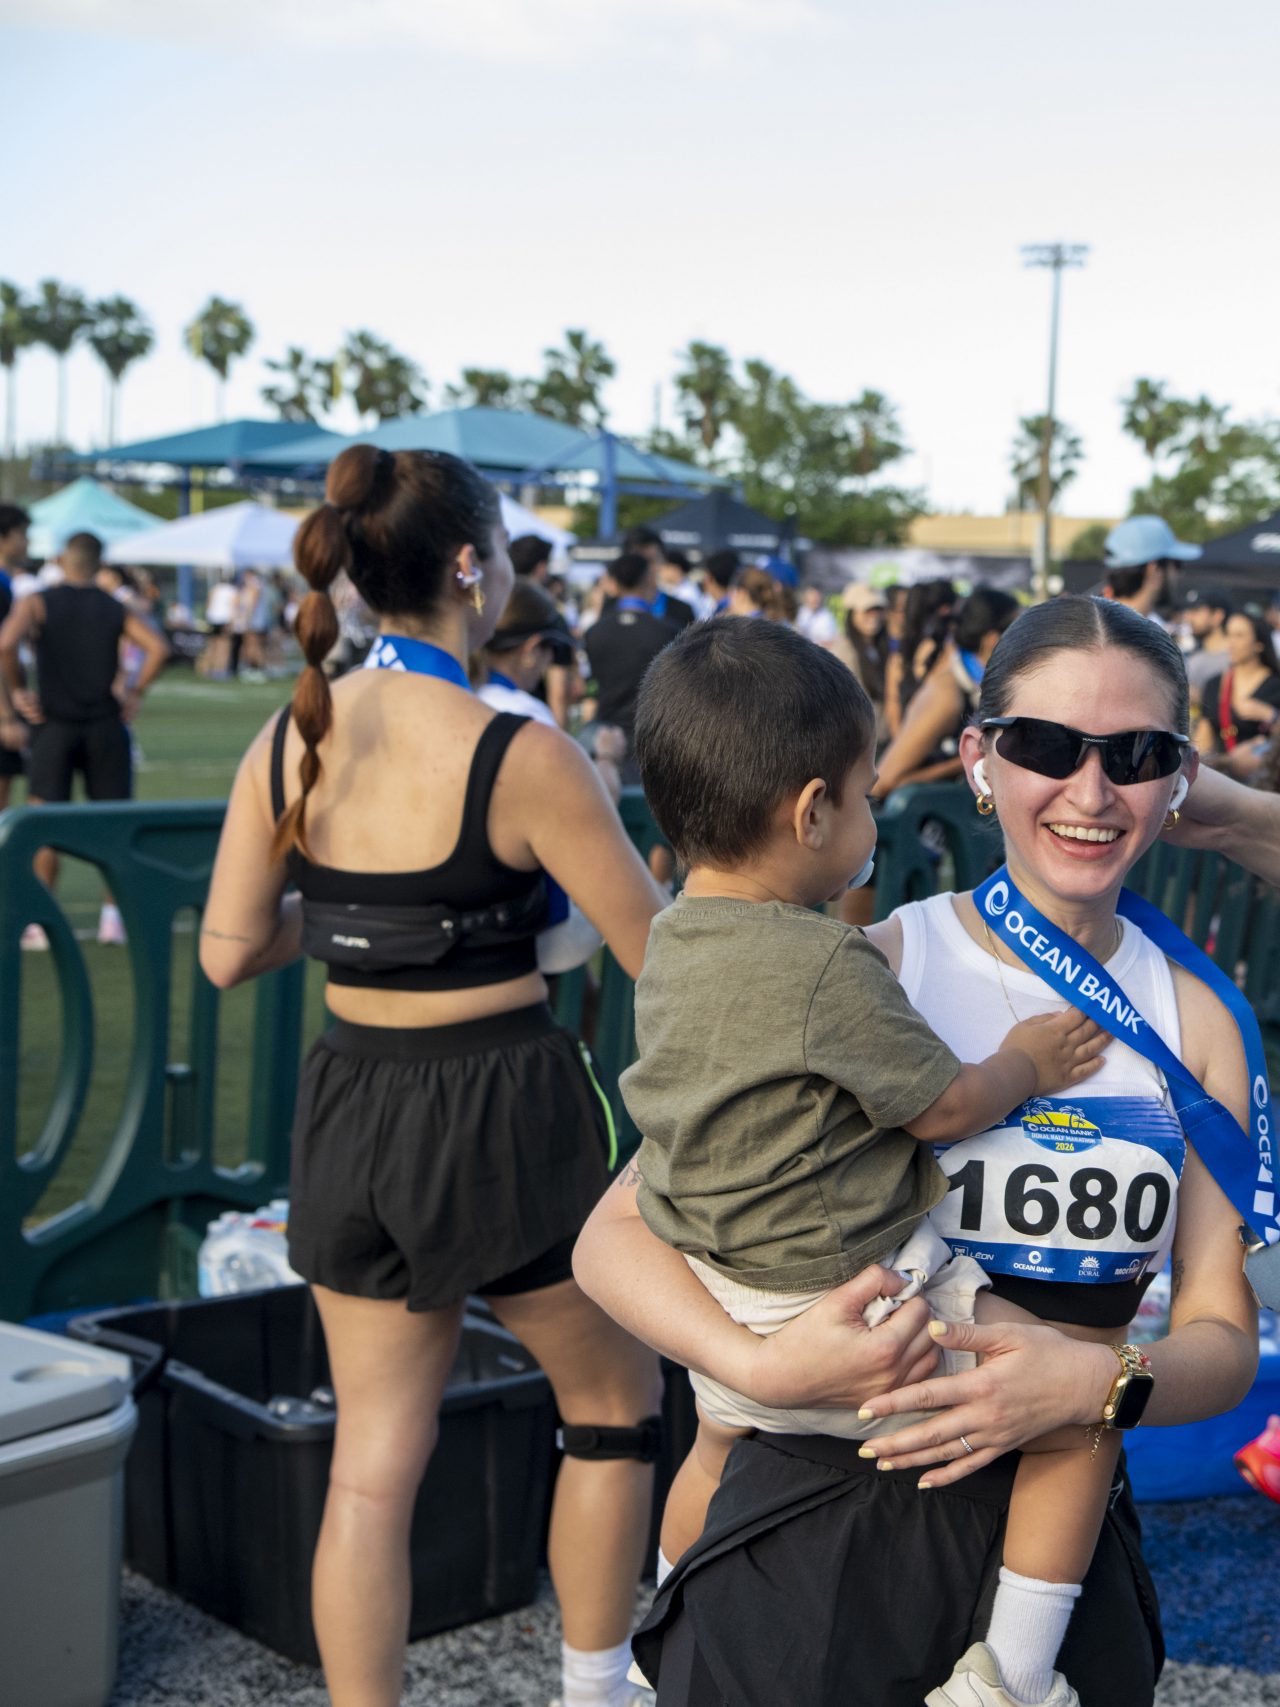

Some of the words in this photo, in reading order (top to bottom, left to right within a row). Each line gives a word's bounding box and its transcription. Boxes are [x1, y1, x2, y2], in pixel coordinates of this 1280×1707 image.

[1004, 910, 1081, 984] OCEAN
[1040, 1126, 1068, 1134] OCEAN
[1257, 1114, 1272, 1165] OCE
[1055, 1142, 1075, 1151] 2026
[947, 1160, 1171, 1243] 1680
[1013, 1262, 1035, 1272] OCEAN
